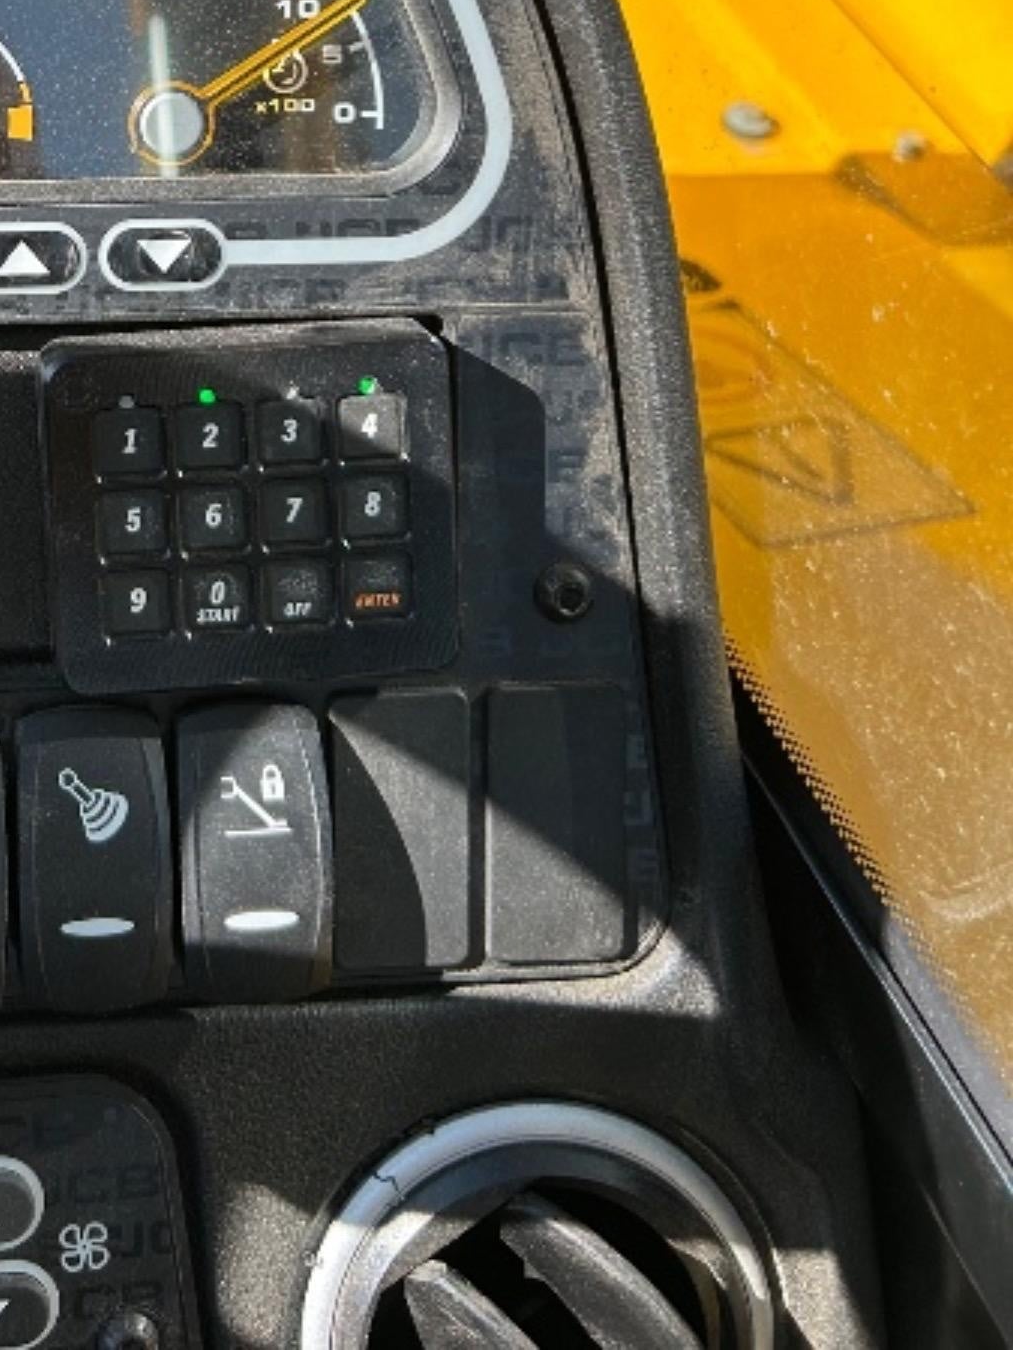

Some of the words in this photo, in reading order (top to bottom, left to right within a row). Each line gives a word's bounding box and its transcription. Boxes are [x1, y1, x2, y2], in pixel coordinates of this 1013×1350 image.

[322, 44, 342, 64] 5
[254, 98, 315, 114] x100
[333, 101, 356, 125] 0
[202, 422, 220, 449] 2
[281, 419, 298, 443] 3
[362, 413, 378, 438] 4
[122, 427, 138, 454] 1
[204, 503, 223, 528] 6
[286, 497, 303, 523] 7
[364, 491, 382, 517] 8
[125, 507, 142, 532] 5
[130, 587, 148, 613] 9
[210, 580, 226, 605] 0
